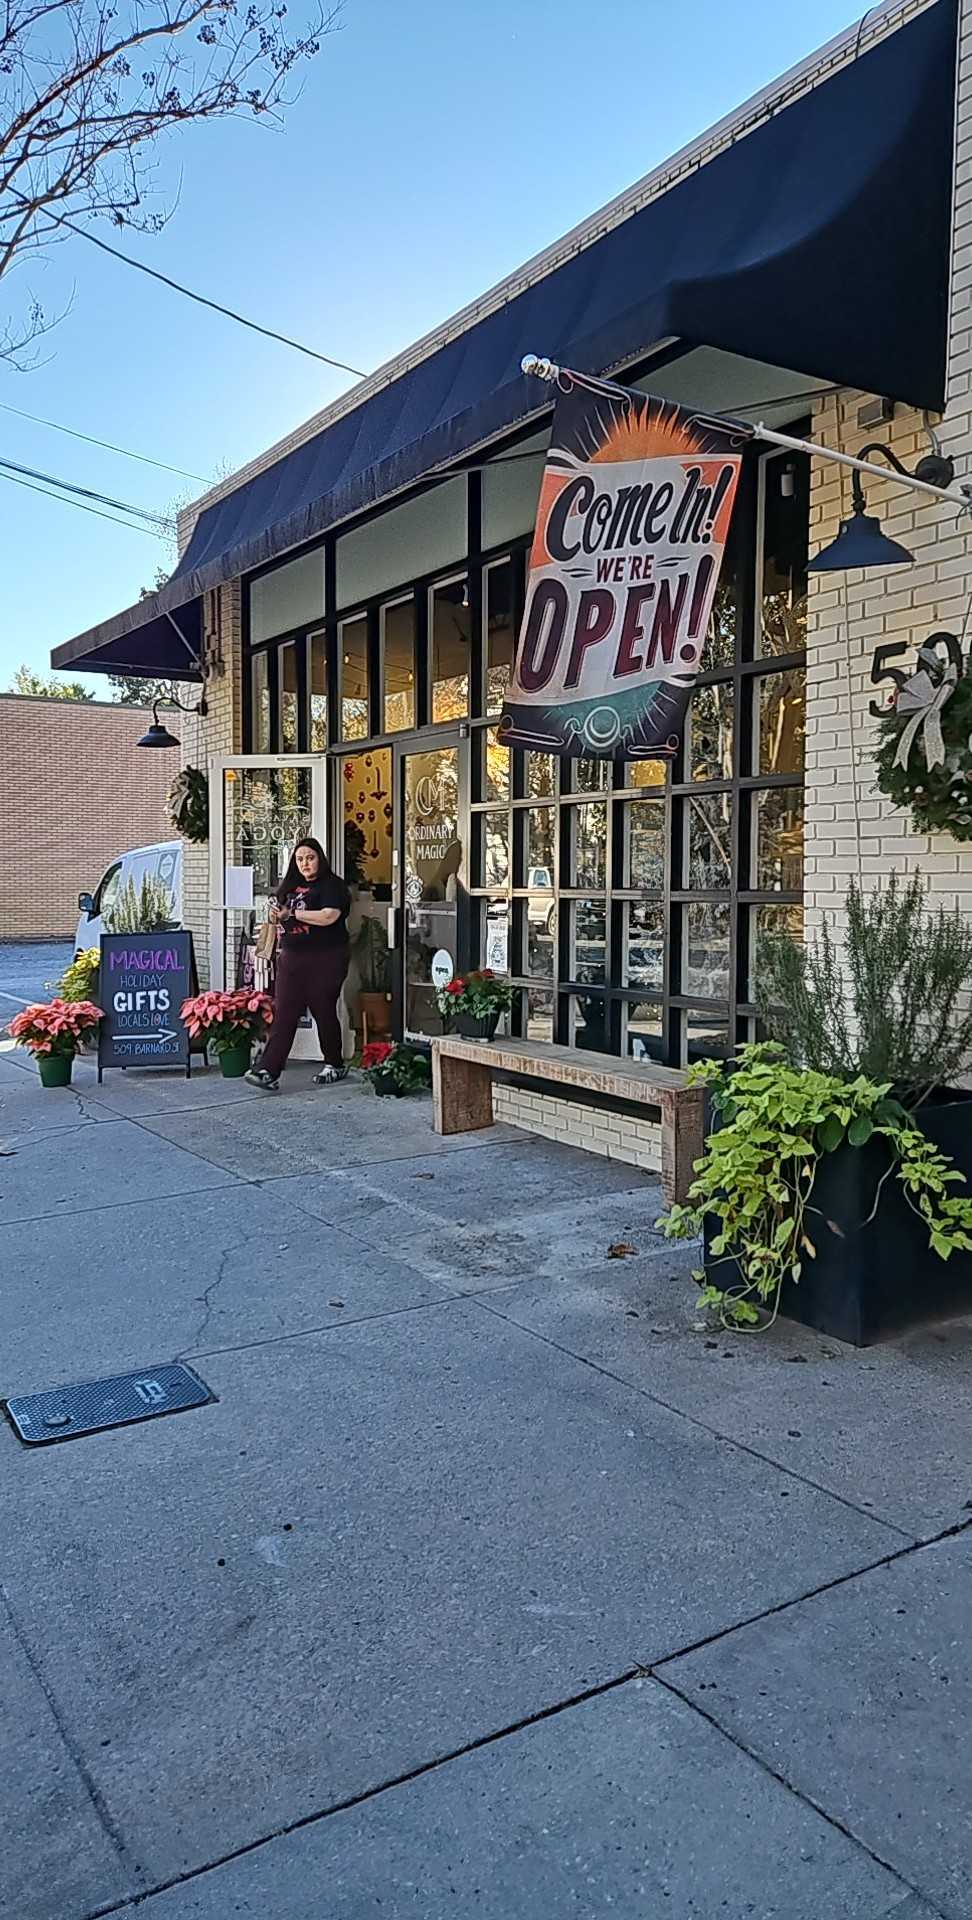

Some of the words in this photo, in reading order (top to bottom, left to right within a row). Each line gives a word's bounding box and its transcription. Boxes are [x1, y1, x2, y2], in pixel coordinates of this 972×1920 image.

[546, 475, 673, 562] Come
[669, 465, 734, 545] In!
[596, 554, 655, 583] WE'RE
[518, 554, 714, 693] OPEN!
[407, 824, 454, 840] ORDINARY
[416, 844, 446, 860] MAGIC
[110, 948, 184, 971] MAGICAL
[120, 974, 165, 988] HOLIDAY
[113, 989, 170, 1012] GIFTS
[118, 1013, 150, 1028] LOCALS
[150, 1012, 170, 1027] LOVE
[113, 1043, 132, 1056] 509
[134, 1042, 171, 1055] BARNARD
